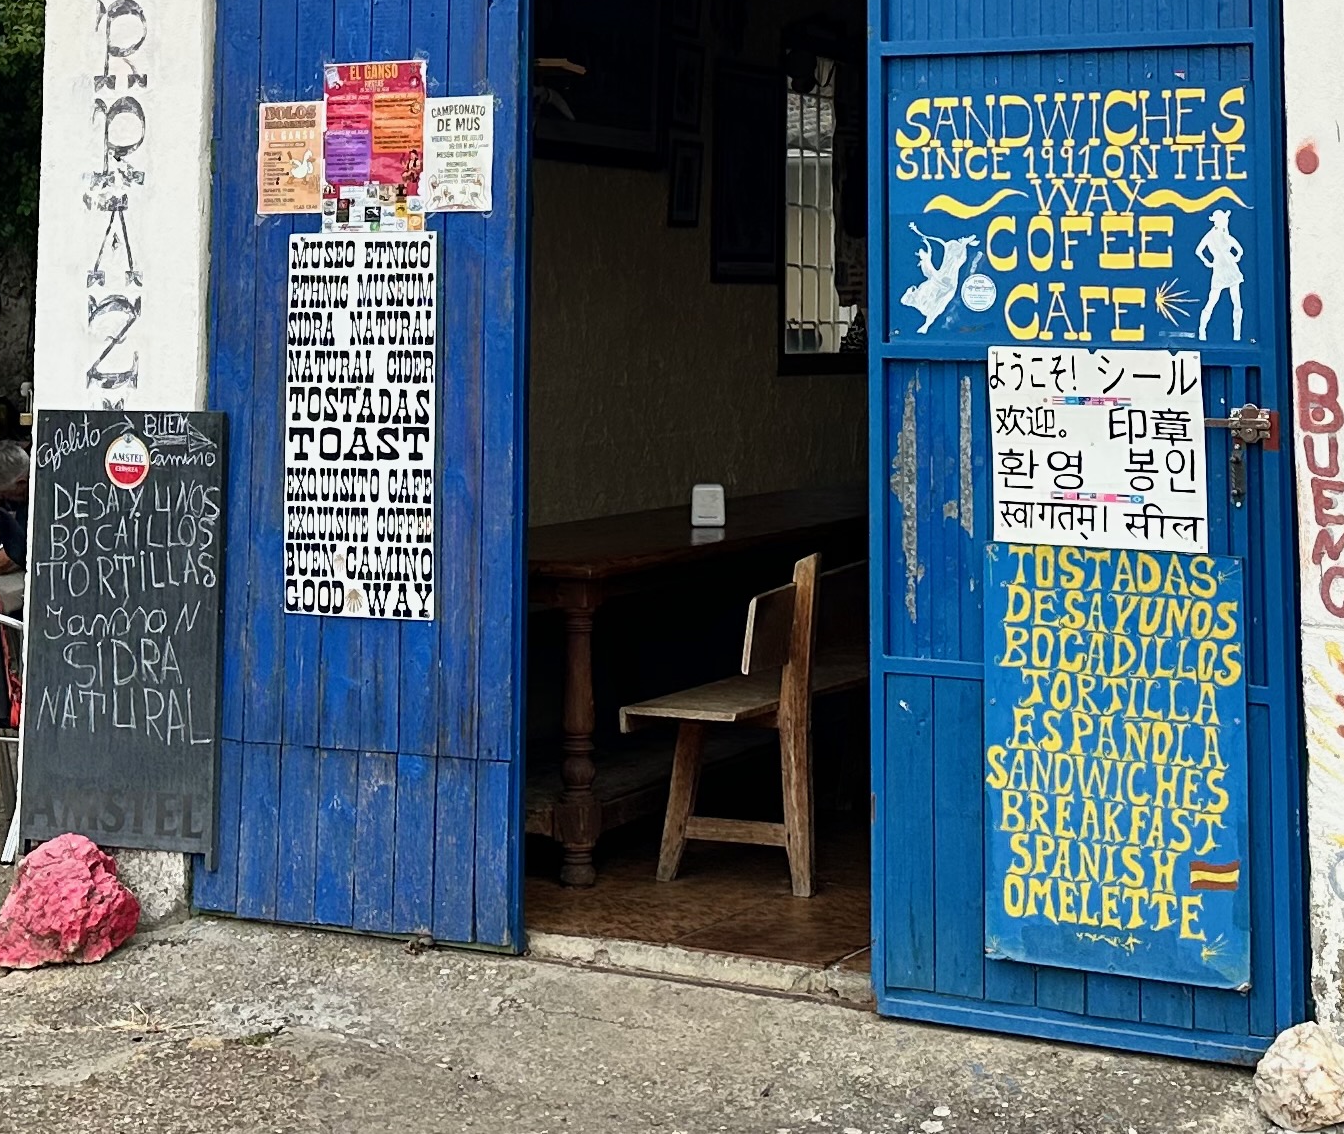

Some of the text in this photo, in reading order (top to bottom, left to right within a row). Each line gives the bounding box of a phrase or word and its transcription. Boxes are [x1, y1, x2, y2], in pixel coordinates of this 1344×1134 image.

[350, 63, 399, 81] EL GANSO
[264, 105, 317, 120] BOLOS
[431, 104, 486, 119] CAMPEONATO
[436, 116, 481, 133] DE MUS
[895, 86, 1246, 149] SANDWICHES
[896, 143, 1248, 181] SINCE 1991 ON THE
[1030, 177, 1146, 217] WAY
[291, 240, 431, 269] MUSEO ETNICO
[986, 215, 1174, 272] COFEE
[290, 272, 434, 309] ETHNIC MUSEUM
[288, 310, 435, 347] SIDRA NATURAL
[1004, 282, 1146, 343] CAFE
[288, 349, 434, 384] NATURAL CIDER
[1097, 355, 1198, 395] シール
[143, 413, 190, 437] BUEN
[289, 386, 430, 425] TOSTADAS
[288, 426, 430, 461] TOAST
[1109, 406, 1193, 446] 印章
[111, 452, 144, 463] AMSTEL
[997, 448, 1197, 494] 환영 봉인
[286, 467, 432, 504] EXQUISITO CAFE
[287, 505, 433, 544] EXQUISITE COFFEE
[285, 542, 433, 582] BUEN CAMINO
[1008, 544, 1218, 599] TOSTADAS
[285, 578, 433, 618] GOOD WAY
[1002, 584, 1238, 640] DESAYUNOS
[996, 622, 1243, 686] BOCADILLOS
[36, 684, 212, 746] NATURAL
[1018, 666, 1221, 725] TORTILLA
[986, 744, 1230, 814] SANDWICHES
[999, 789, 1228, 856] BREAKFAST
[1006, 833, 1181, 895] SPANISH
[1003, 874, 1207, 941] OMELETTE
